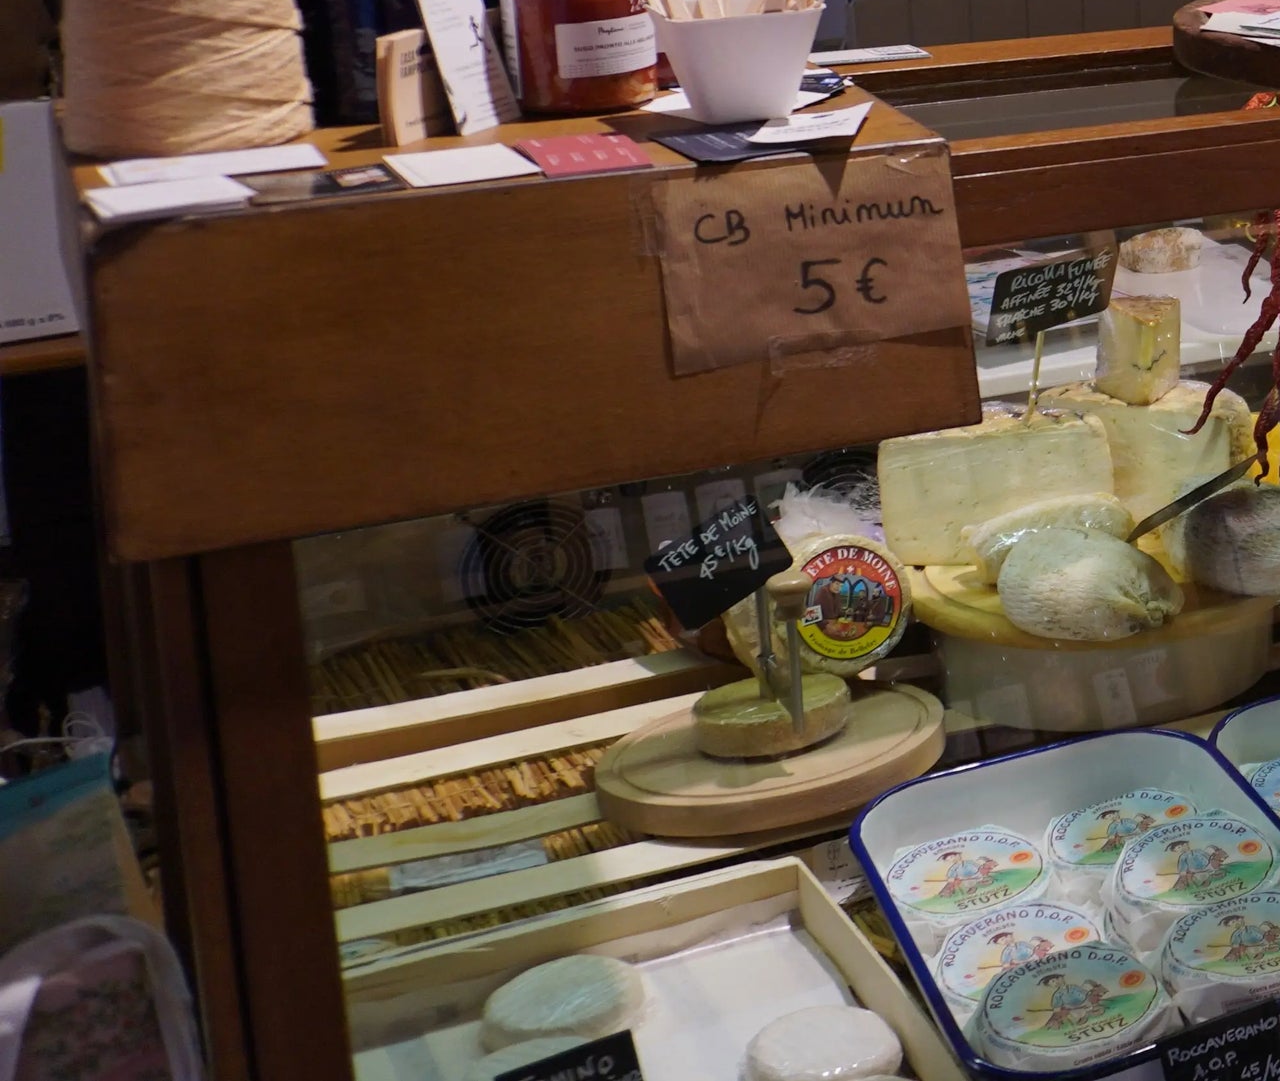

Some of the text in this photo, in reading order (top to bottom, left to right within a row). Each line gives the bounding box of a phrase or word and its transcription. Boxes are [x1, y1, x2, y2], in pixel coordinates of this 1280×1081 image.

[694, 209, 750, 246] CB
[792, 258, 887, 314] 5 €
[700, 524, 720, 546] DE
[837, 548, 897, 591] DE MOINE
[892, 836, 980, 882] ROCCAVERANO
[957, 887, 1013, 911] STUTZ
[943, 908, 1029, 968] ROCCAVERANO
[1068, 1016, 1127, 1043] STUTZ
[1168, 1016, 1278, 1067] ROCCAVERANO
